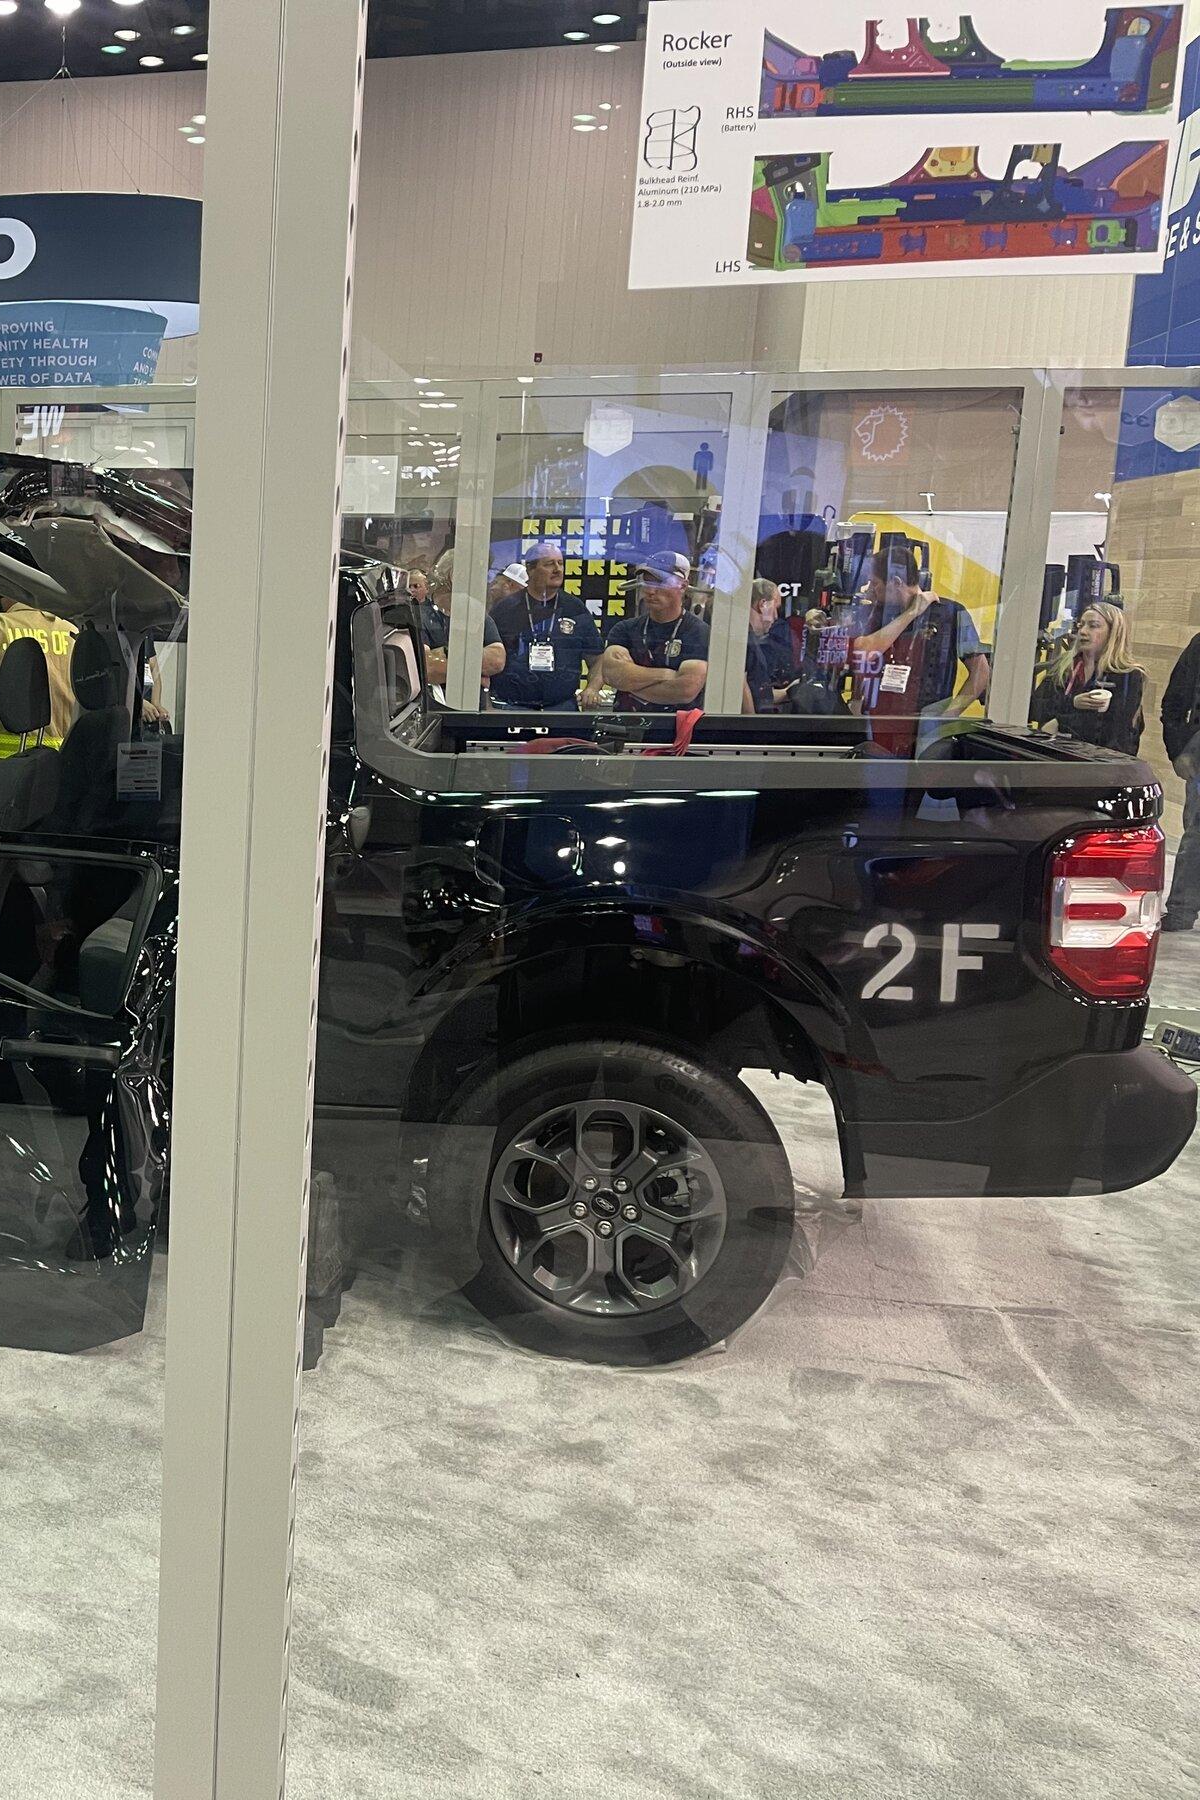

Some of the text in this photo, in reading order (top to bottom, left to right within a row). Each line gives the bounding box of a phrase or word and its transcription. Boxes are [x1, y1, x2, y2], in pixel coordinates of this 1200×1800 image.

[662, 30, 733, 52] Rocker
[663, 57, 722, 69] (Outside view)
[726, 106, 754, 119] RHS
[721, 122, 757, 133] (Battery)
[639, 175, 676, 185] Bulkhead
[638, 184, 722, 196] Aluminum (210 MPa)
[638, 199, 665, 208] 1.8-2.0
[1165, 222, 1180, 260] E
[715, 260, 741, 273] LHS
[33, 338, 89, 350] HEALTH
[29, 355, 98, 367] THROUGH
[30, 373, 50, 384] OF
[54, 372, 93, 384] DATA
[777, 582, 802, 597] CT
[51, 630, 69, 655] OF
